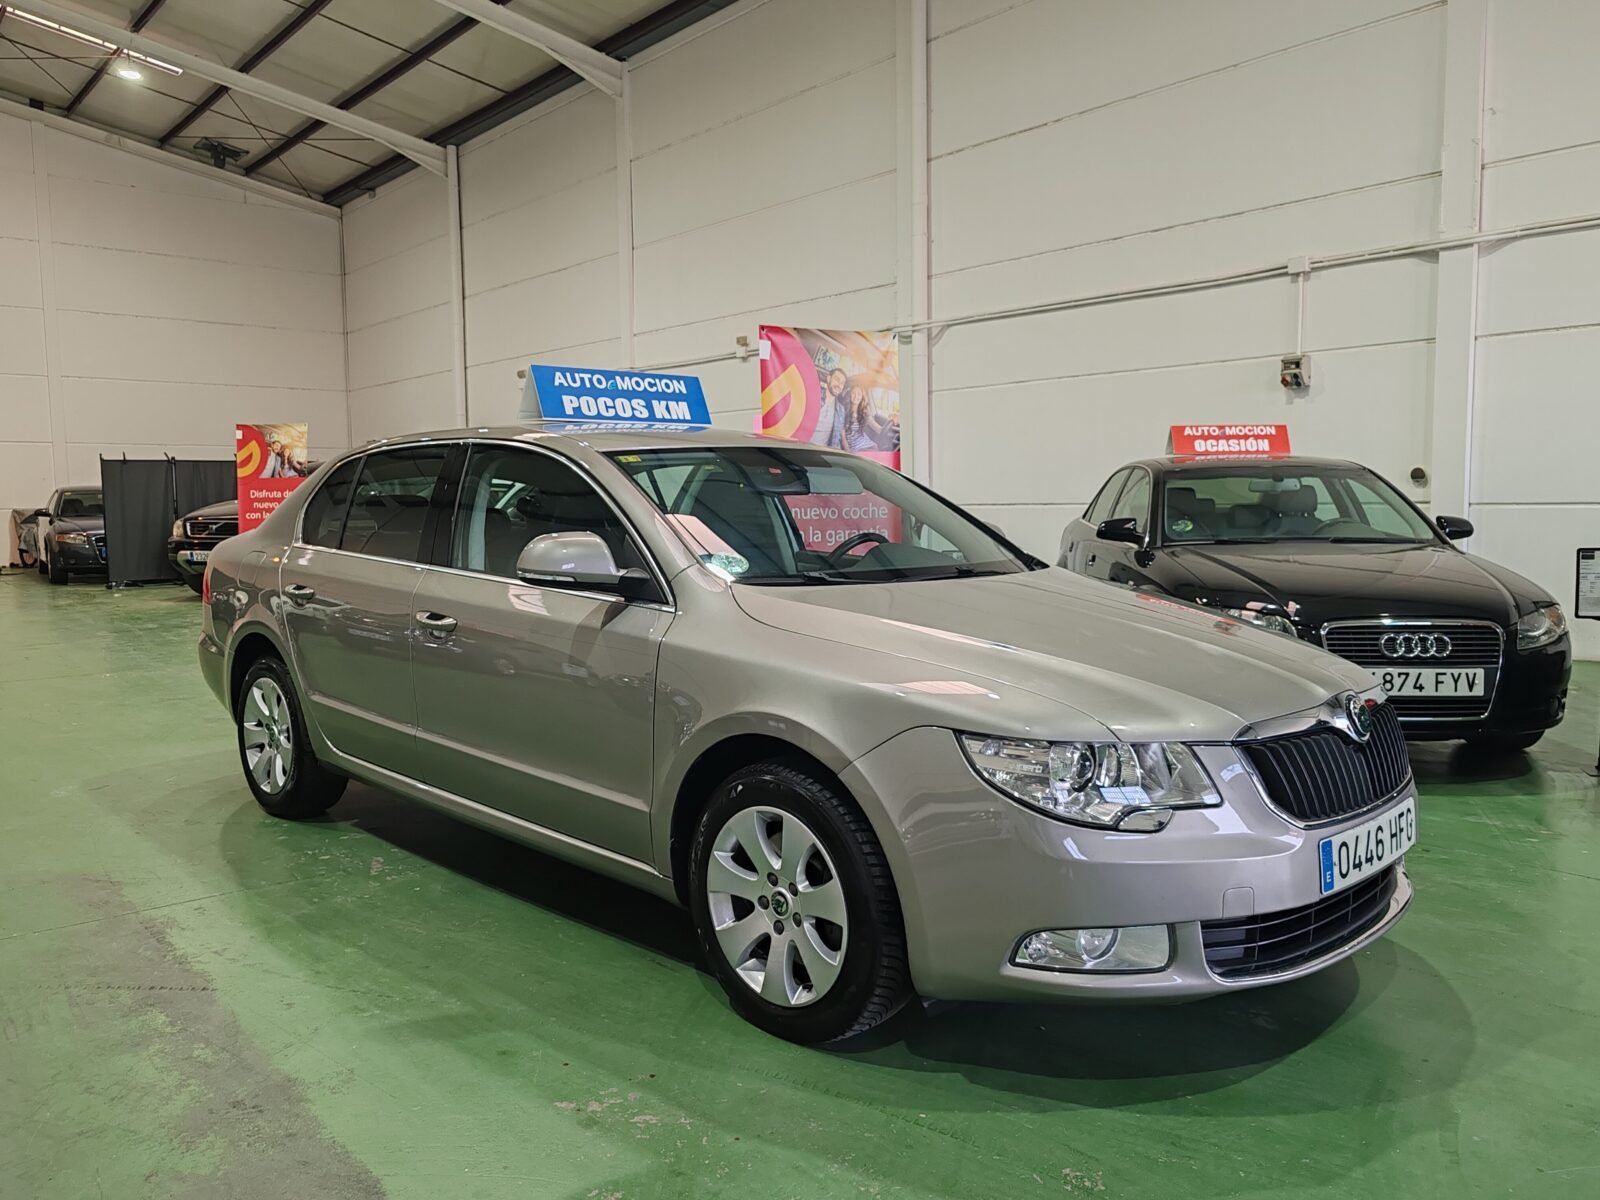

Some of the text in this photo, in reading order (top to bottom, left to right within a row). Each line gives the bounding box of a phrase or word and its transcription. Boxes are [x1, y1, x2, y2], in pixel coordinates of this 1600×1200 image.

[562, 395, 691, 420] POCOS KM
[1194, 437, 1270, 452] OCASIÓN
[250, 489, 282, 499] Disfruta
[253, 501, 279, 509] nuevo
[791, 503, 888, 519] nuevo coche
[246, 512, 261, 520] con
[809, 526, 822, 542] la
[1372, 672, 1477, 692] 874 FYV
[1326, 808, 1413, 882] E 0446 HFG
